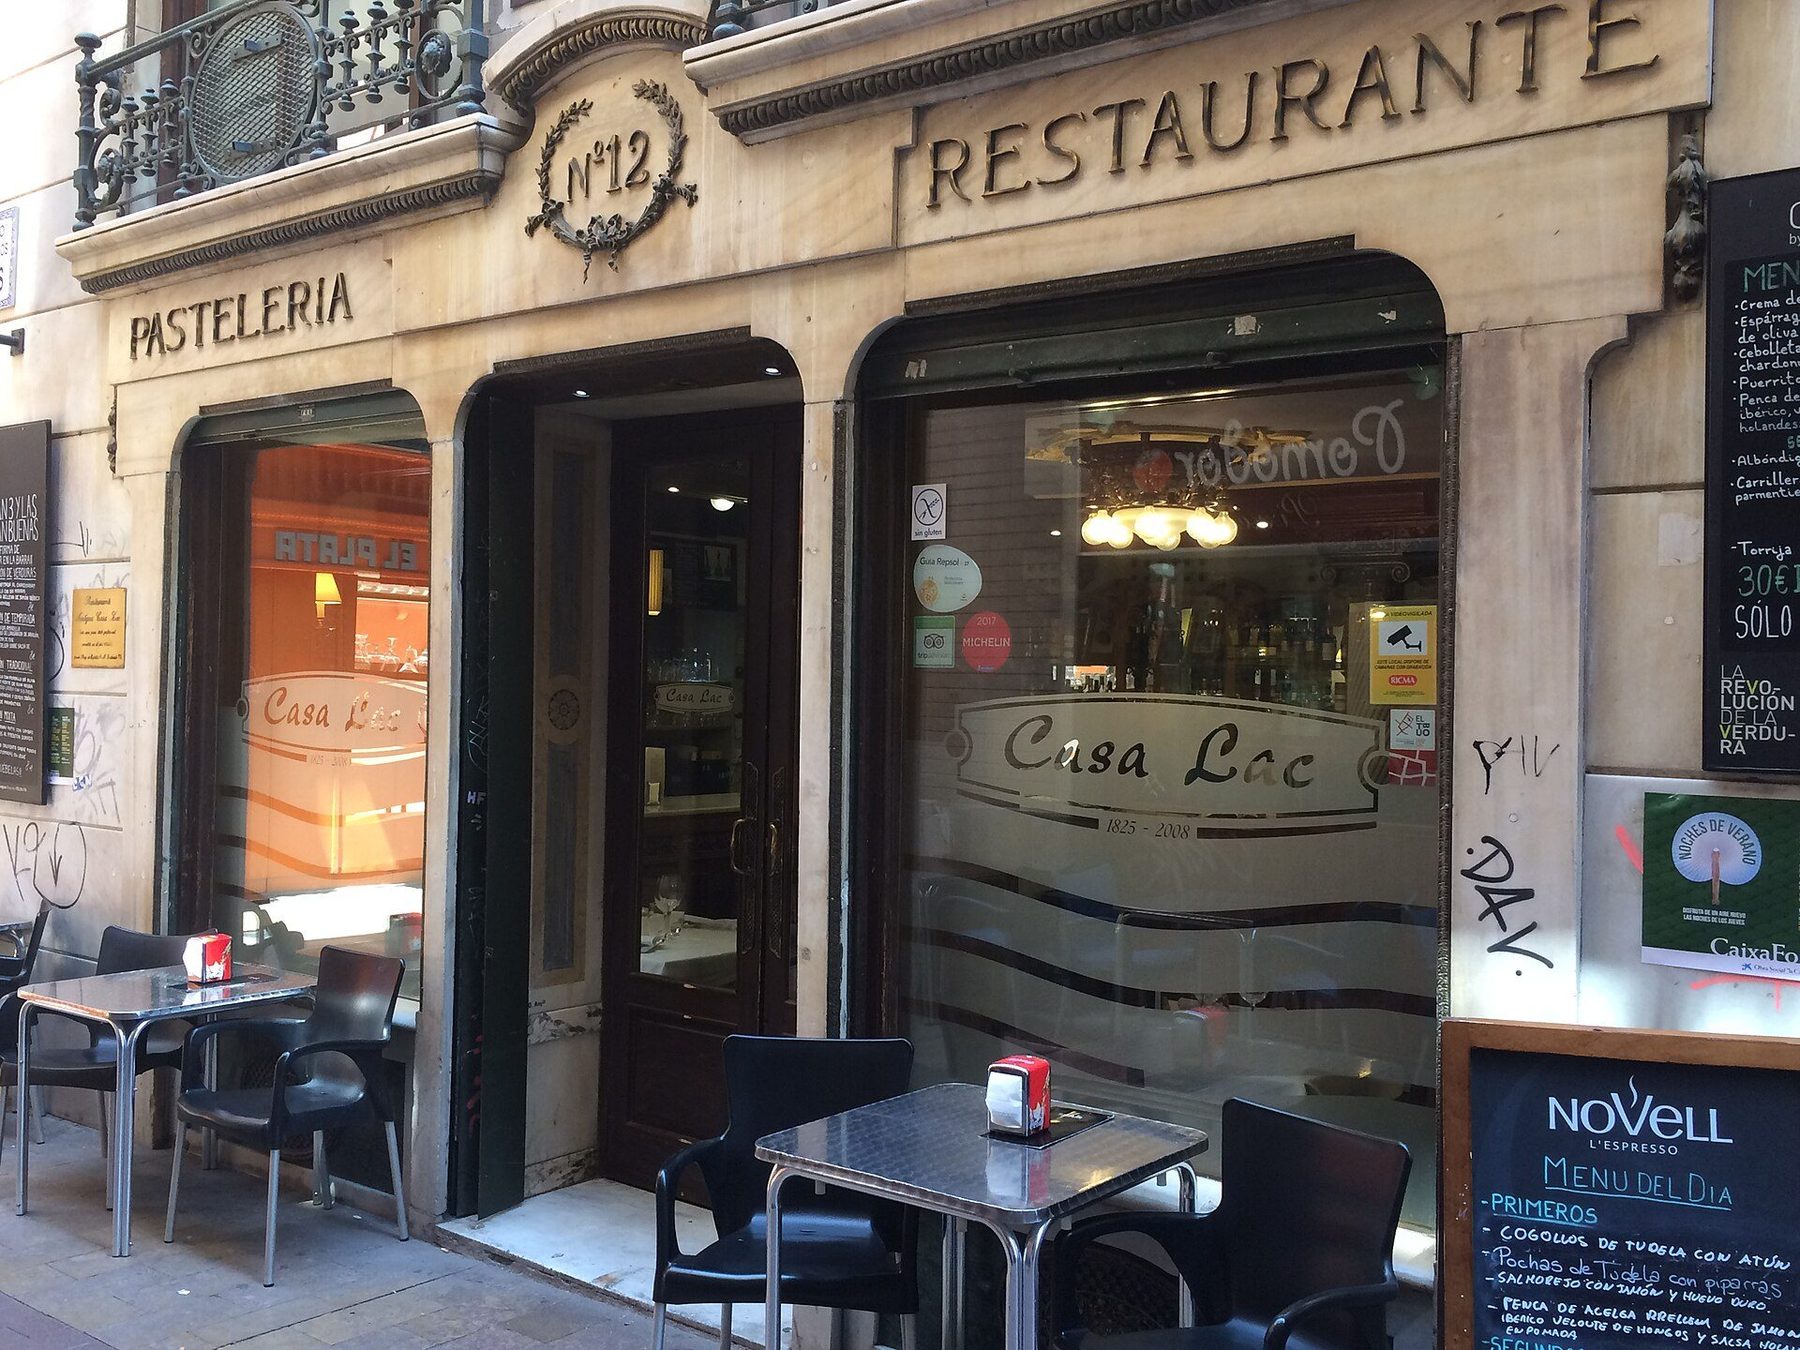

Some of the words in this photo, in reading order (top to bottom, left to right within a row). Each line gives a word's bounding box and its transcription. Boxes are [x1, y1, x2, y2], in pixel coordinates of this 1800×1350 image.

[926, 0, 1661, 210] RESTAURANTE
[130, 272, 354, 360] PASTELERIA
[1740, 299, 1780, 311] Crema
[1738, 328, 1756, 344] de
[1762, 324, 1799, 340] oliva
[1740, 392, 1778, 408] Penca
[1784, 387, 1800, 402] de
[1738, 564, 1790, 597] 30€
[976, 616, 997, 626] 2017
[1734, 600, 1792, 639] SÓLO
[962, 637, 1011, 647] MICHELIN
[1721, 665, 1744, 680] LA
[666, 688, 694, 703] Casa
[700, 688, 723, 703] Lac
[1721, 680, 1781, 695] REVO-
[264, 686, 330, 729] Casa
[344, 691, 401, 732] Lac
[1721, 692, 1795, 711] LUCIÓN
[1721, 710, 1746, 725] DE
[1753, 710, 1777, 725] LA
[1719, 725, 1796, 741] VERDU-
[1004, 714, 1149, 778] Casa
[1183, 722, 1314, 788] Lac
[1720, 740, 1746, 755] RA
[1106, 818, 1137, 835] 1825
[1154, 822, 1191, 841] 2008
[1678, 821, 1708, 860] NOCHES
[1709, 818, 1725, 833] DE
[1727, 822, 1756, 866] VERANO
[1589, 1139, 1678, 1156] L'ESPRESSO
[1544, 1155, 1629, 1192] MENU
[1638, 1172, 1682, 1200] DEL
[1500, 1226, 1589, 1247] COGOLLOS
[1598, 1237, 1619, 1251] DE
[1625, 1240, 1687, 1259] TUDELA
[1693, 1249, 1731, 1262] CON
[1492, 1246, 1564, 1273] Pochas
[1569, 1257, 1594, 1276] de
[1593, 1259, 1660, 1284] Tudela
[1668, 1274, 1698, 1288] con
[1704, 1278, 1782, 1298] piparras
[1497, 1271, 1581, 1289] SALMOREJO
[1585, 1280, 1615, 1292] CON
[1669, 1289, 1678, 1303] Y
[1503, 1296, 1549, 1312] PENCA
[1557, 1302, 1578, 1314] DE
[1583, 1304, 1637, 1320] ACELGA
[1722, 1318, 1744, 1332] DE
[1612, 1323, 1634, 1334] DE
[1636, 1325, 1689, 1342] HONGOS
[1697, 1331, 1707, 1345] Y
